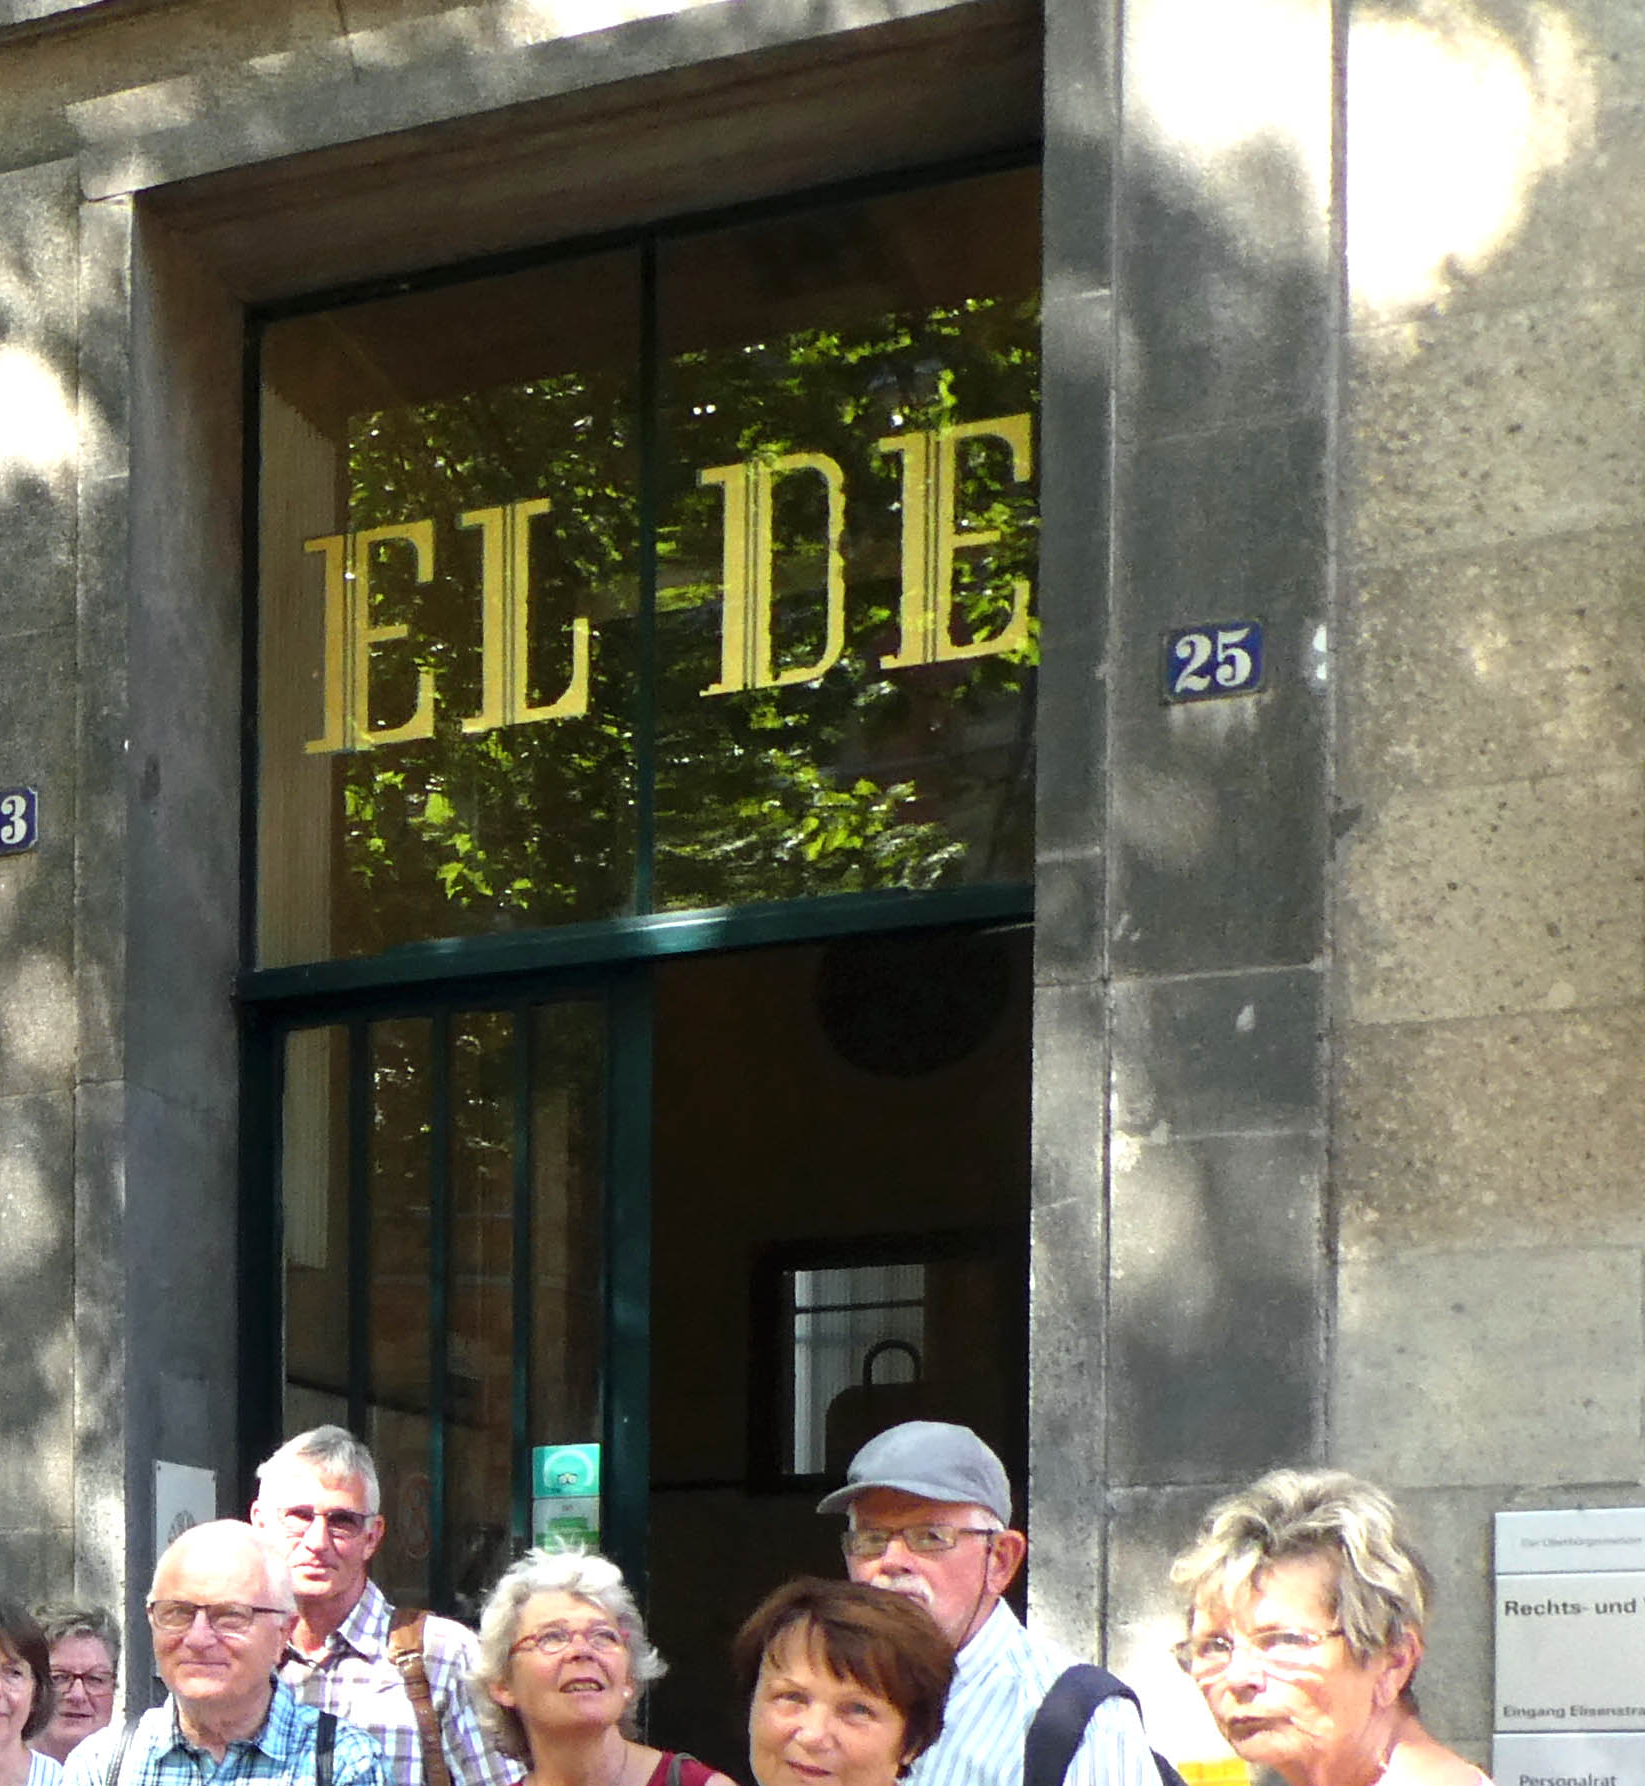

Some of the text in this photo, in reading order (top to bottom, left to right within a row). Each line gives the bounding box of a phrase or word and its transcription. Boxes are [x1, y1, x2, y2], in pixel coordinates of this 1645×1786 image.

[304, 412, 1032, 754] EL DE
[1174, 627, 1252, 693] 25
[1504, 1598, 1637, 1617] Rechts- und
[1503, 1705, 1566, 1719] Eingang
